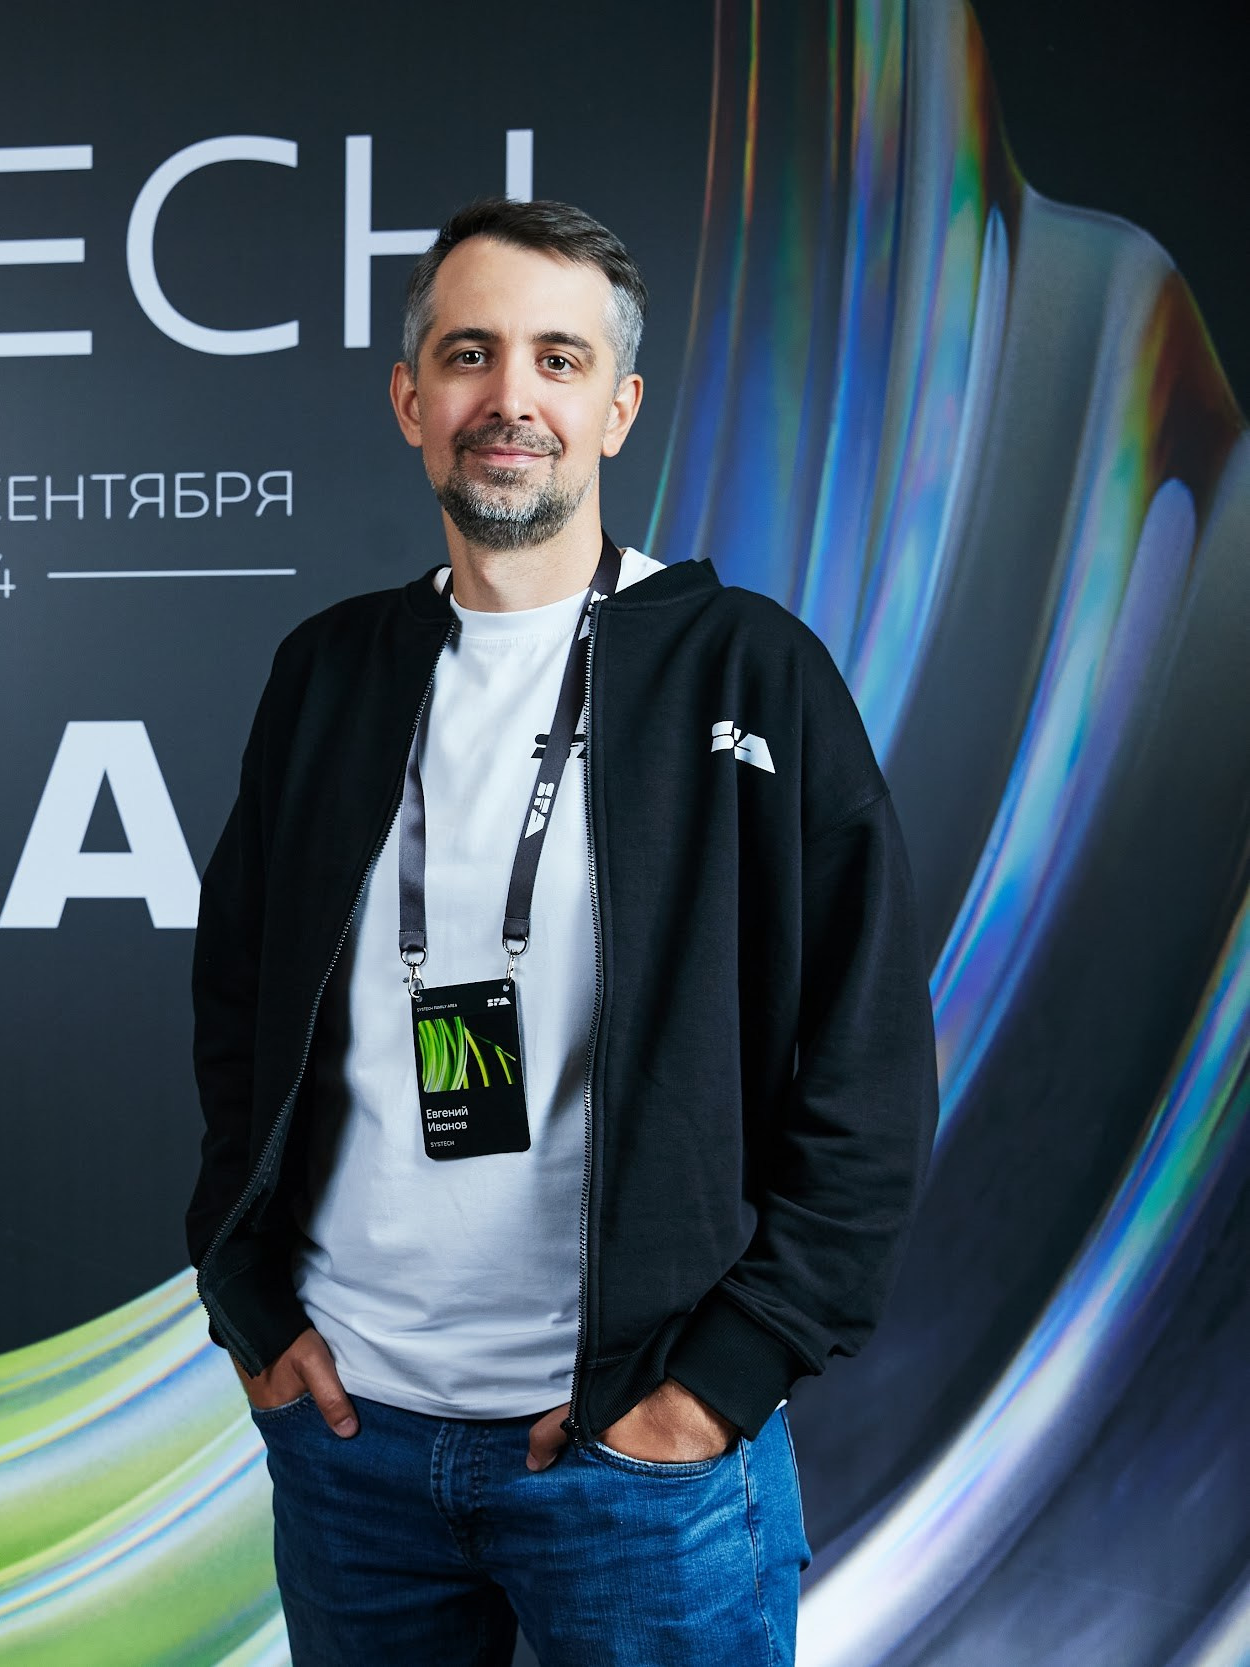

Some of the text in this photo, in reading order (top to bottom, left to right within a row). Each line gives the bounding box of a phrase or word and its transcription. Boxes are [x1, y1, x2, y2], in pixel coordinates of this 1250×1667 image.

[426, 1105, 469, 1120] Евгений
[427, 1121, 468, 1133] Иванов
[430, 1140, 455, 1148] SYSTECH
